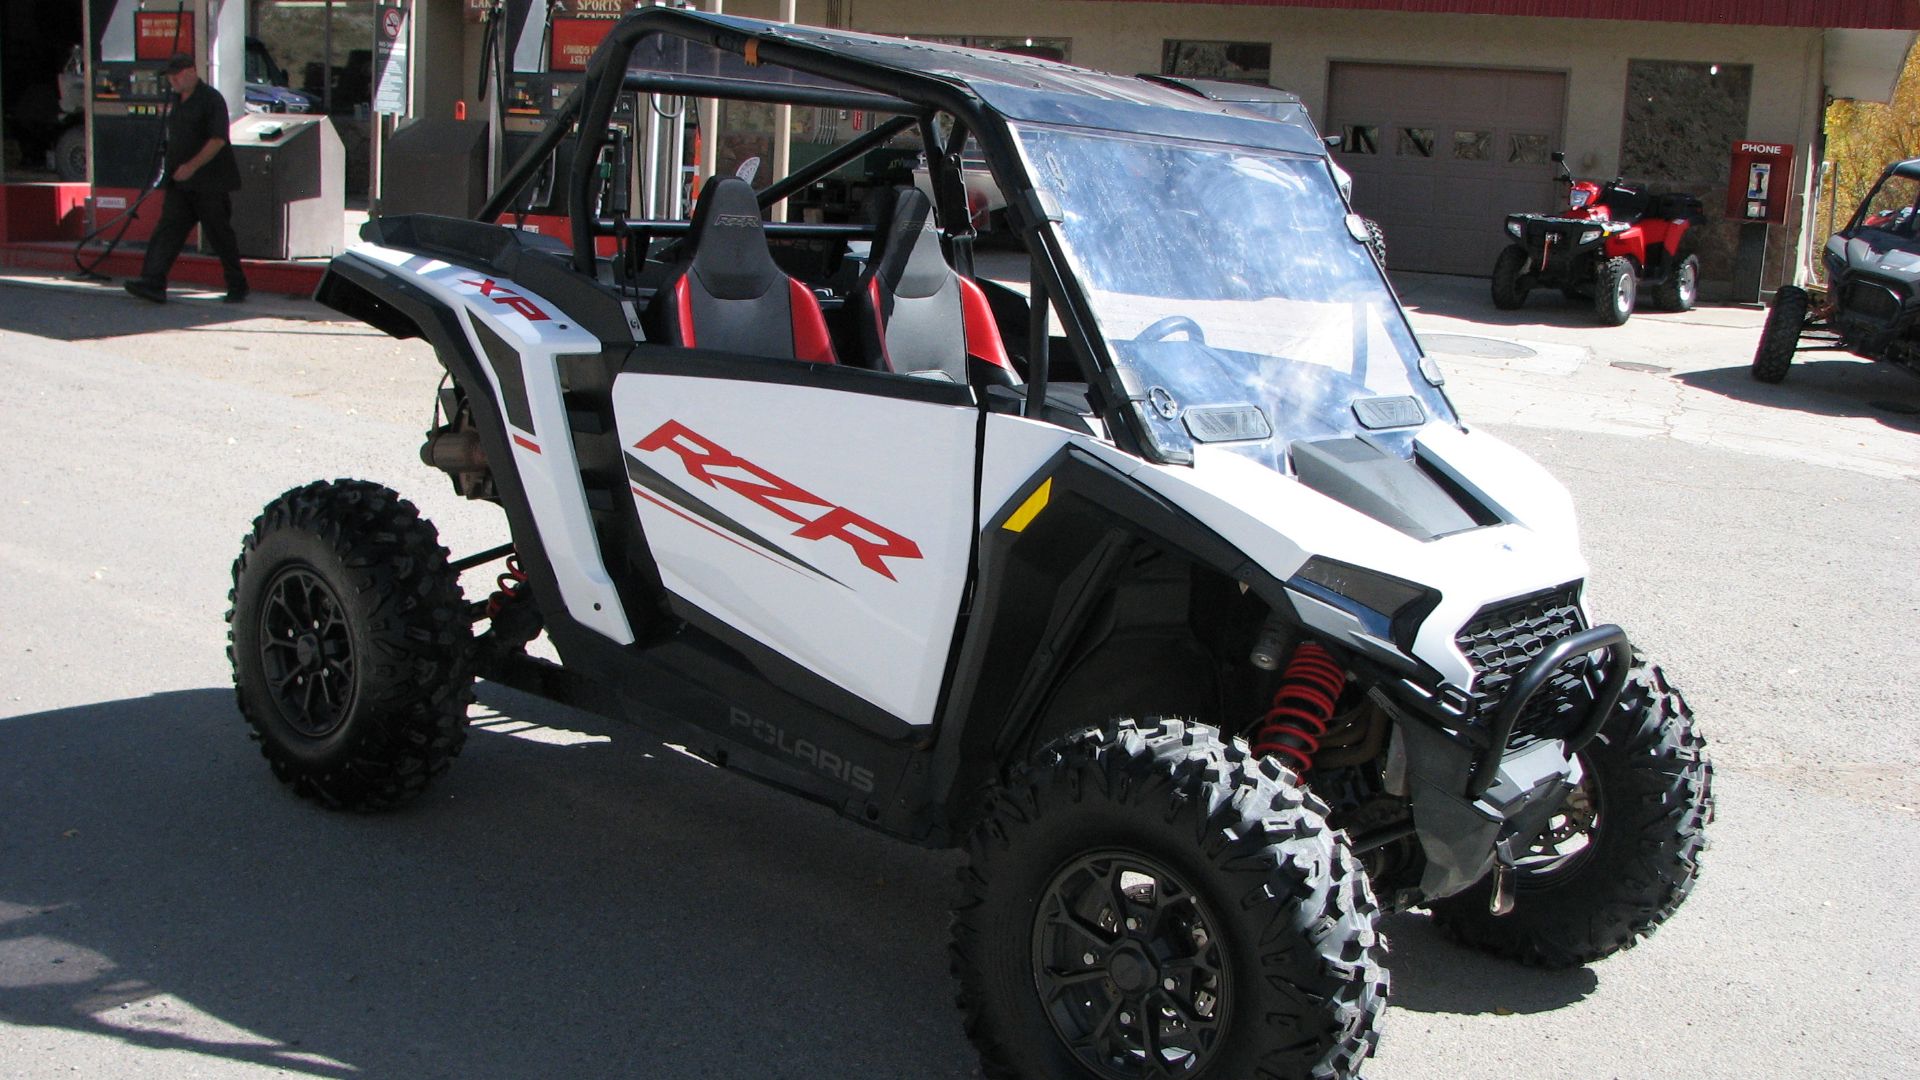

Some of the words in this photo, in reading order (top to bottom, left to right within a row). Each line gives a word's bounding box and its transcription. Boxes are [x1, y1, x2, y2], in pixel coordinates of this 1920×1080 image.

[576, 0, 621, 11] SPORTS
[1741, 143, 1782, 155] PHONE
[714, 213, 760, 230] RZR
[458, 278, 552, 321] XP
[633, 418, 924, 583] RZR
[729, 705, 875, 793] POLARIS
